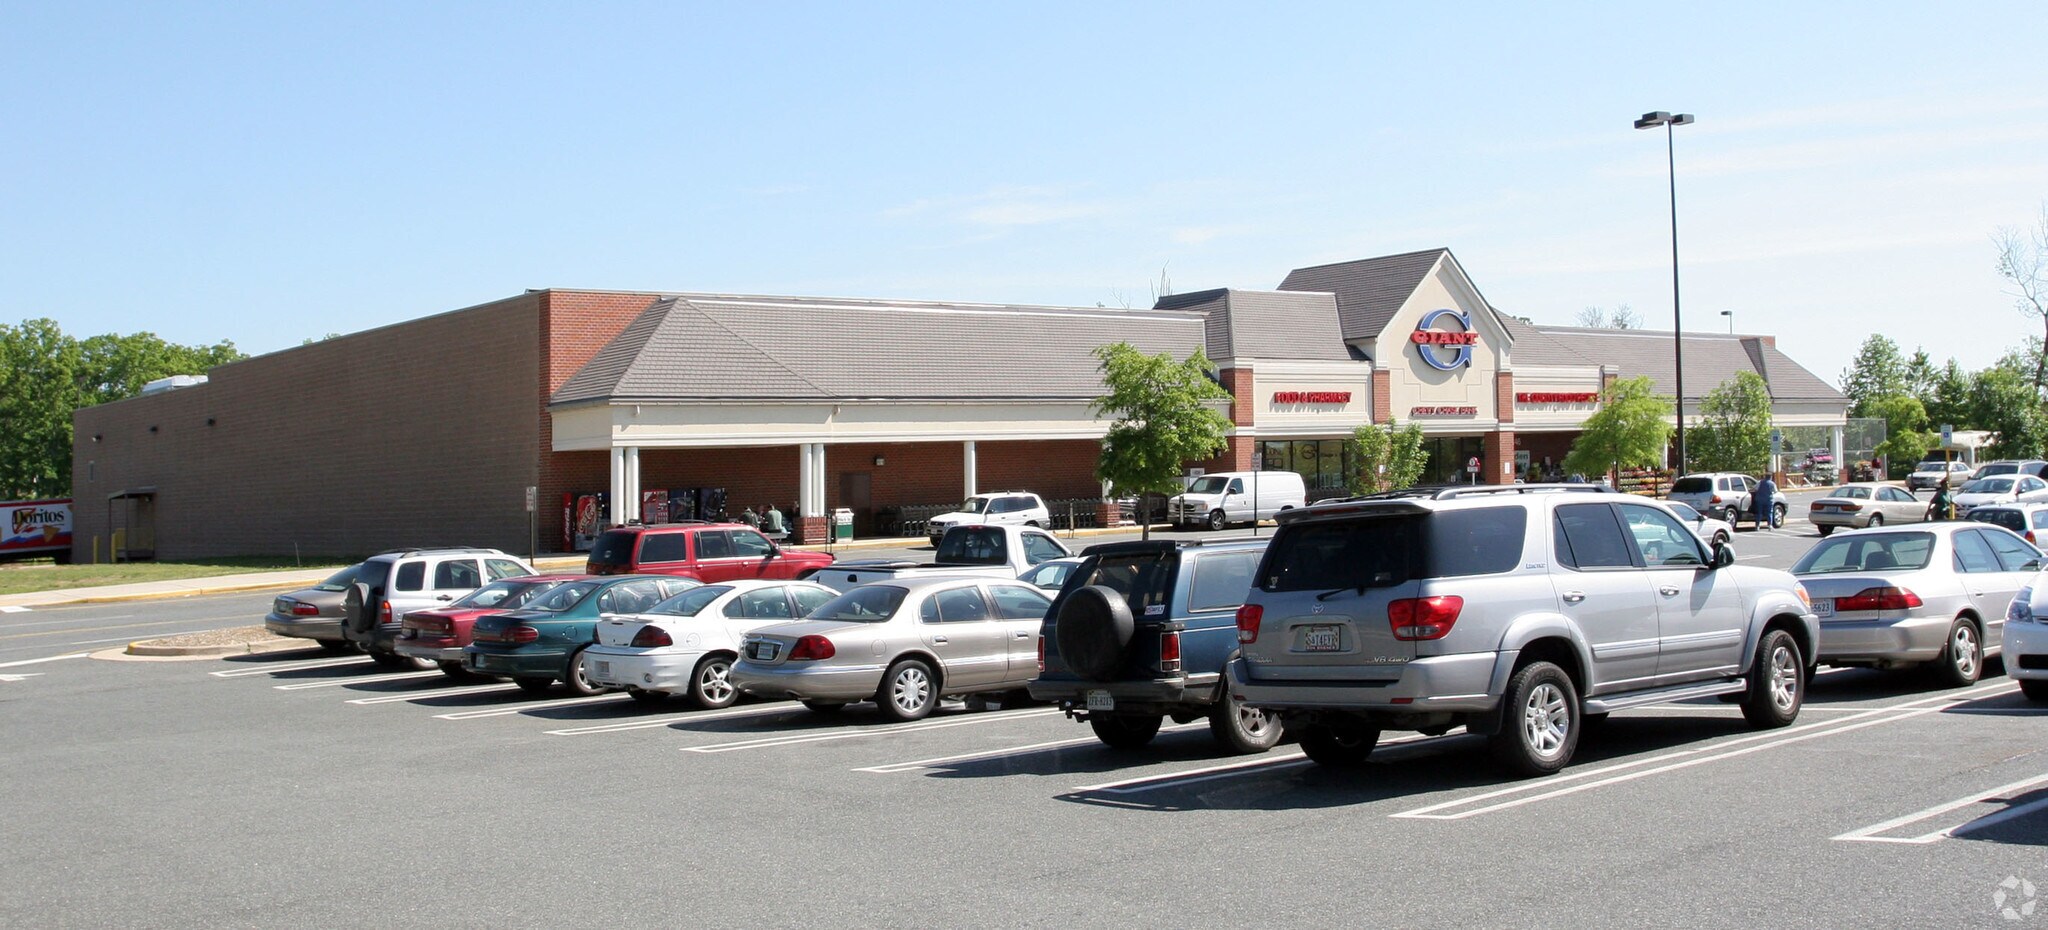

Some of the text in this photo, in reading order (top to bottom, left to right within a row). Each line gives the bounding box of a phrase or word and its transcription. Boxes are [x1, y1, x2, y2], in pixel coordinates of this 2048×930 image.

[1410, 330, 1479, 345] GIANT
[1274, 392, 1299, 403] FOOD
[1307, 392, 1351, 403] PHARMACY
[13, 508, 65, 525] Doritos
